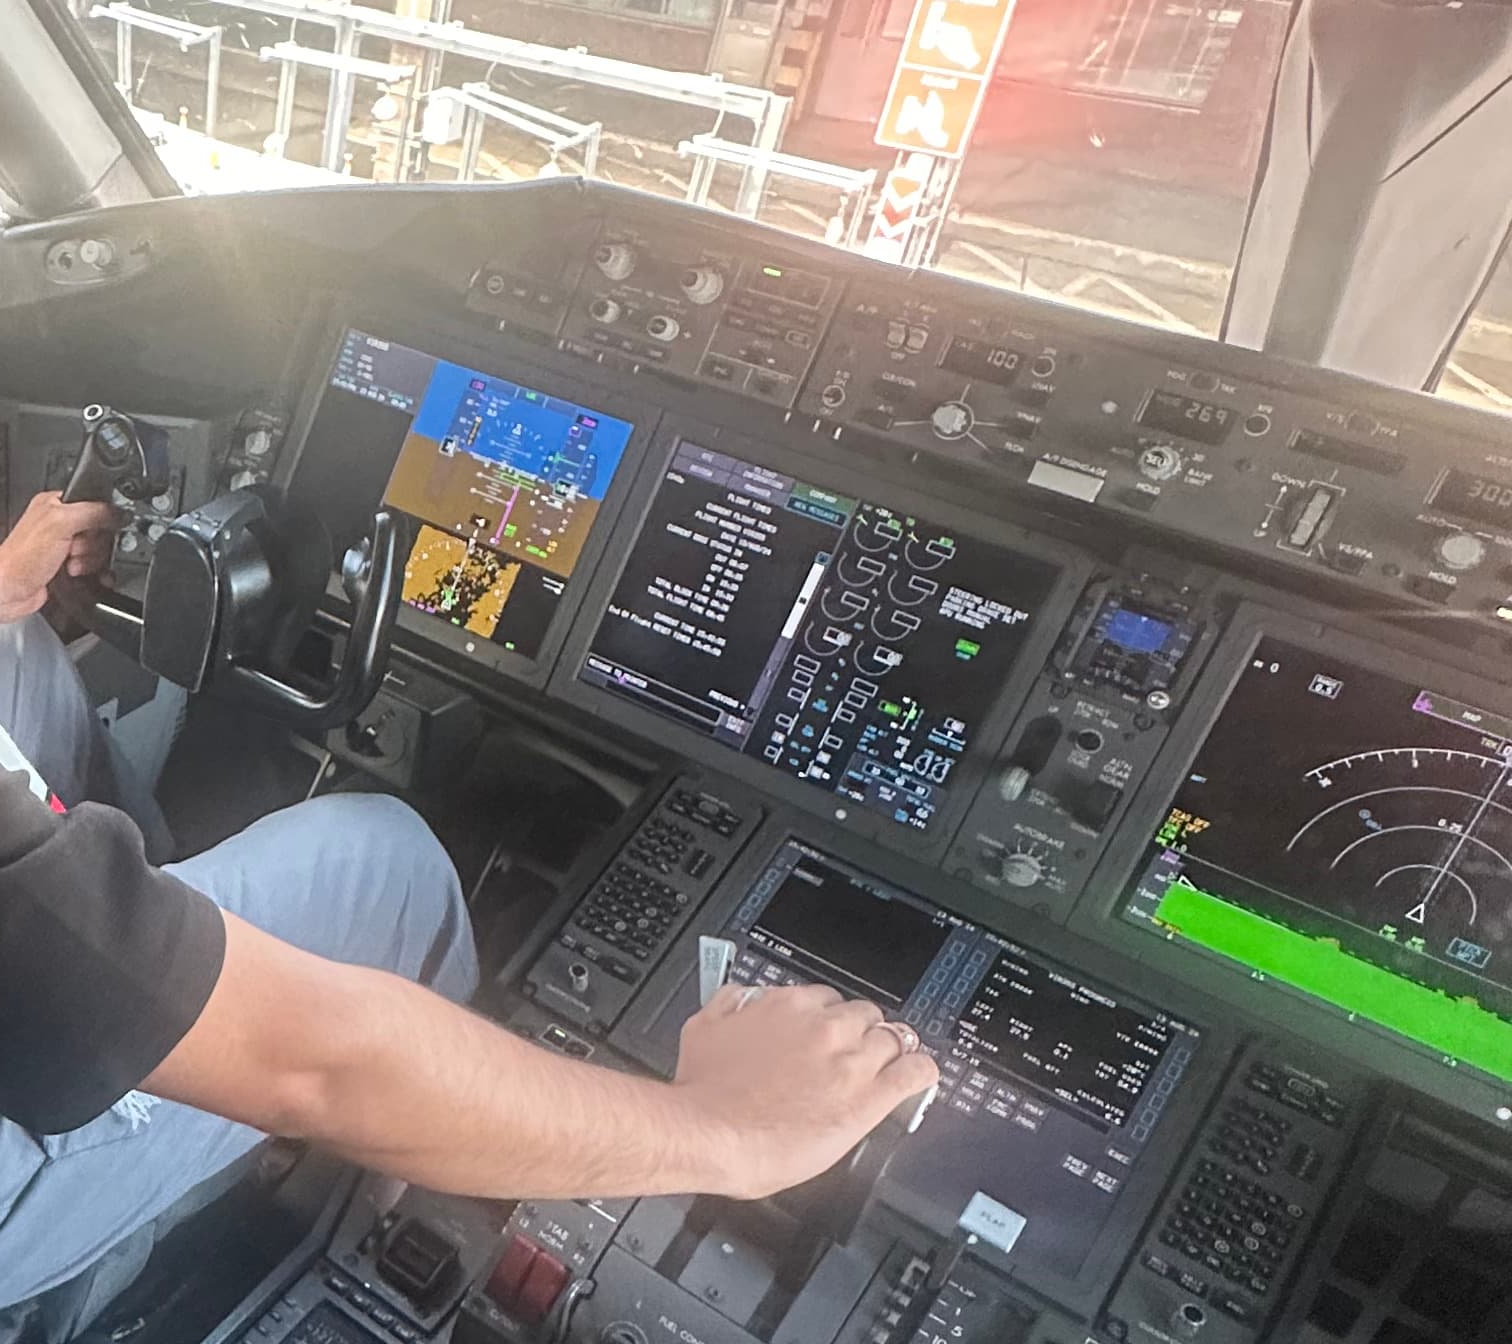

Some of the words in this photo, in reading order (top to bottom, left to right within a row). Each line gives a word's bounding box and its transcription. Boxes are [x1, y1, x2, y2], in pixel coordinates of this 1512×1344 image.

[986, 347, 1019, 370] 100
[1184, 401, 1227, 427] 269
[1271, 471, 1306, 488] DOWN
[1427, 568, 1458, 584] HOLD
[658, 1316, 678, 1334] FUEL
[951, 1326, 964, 1337] 5
